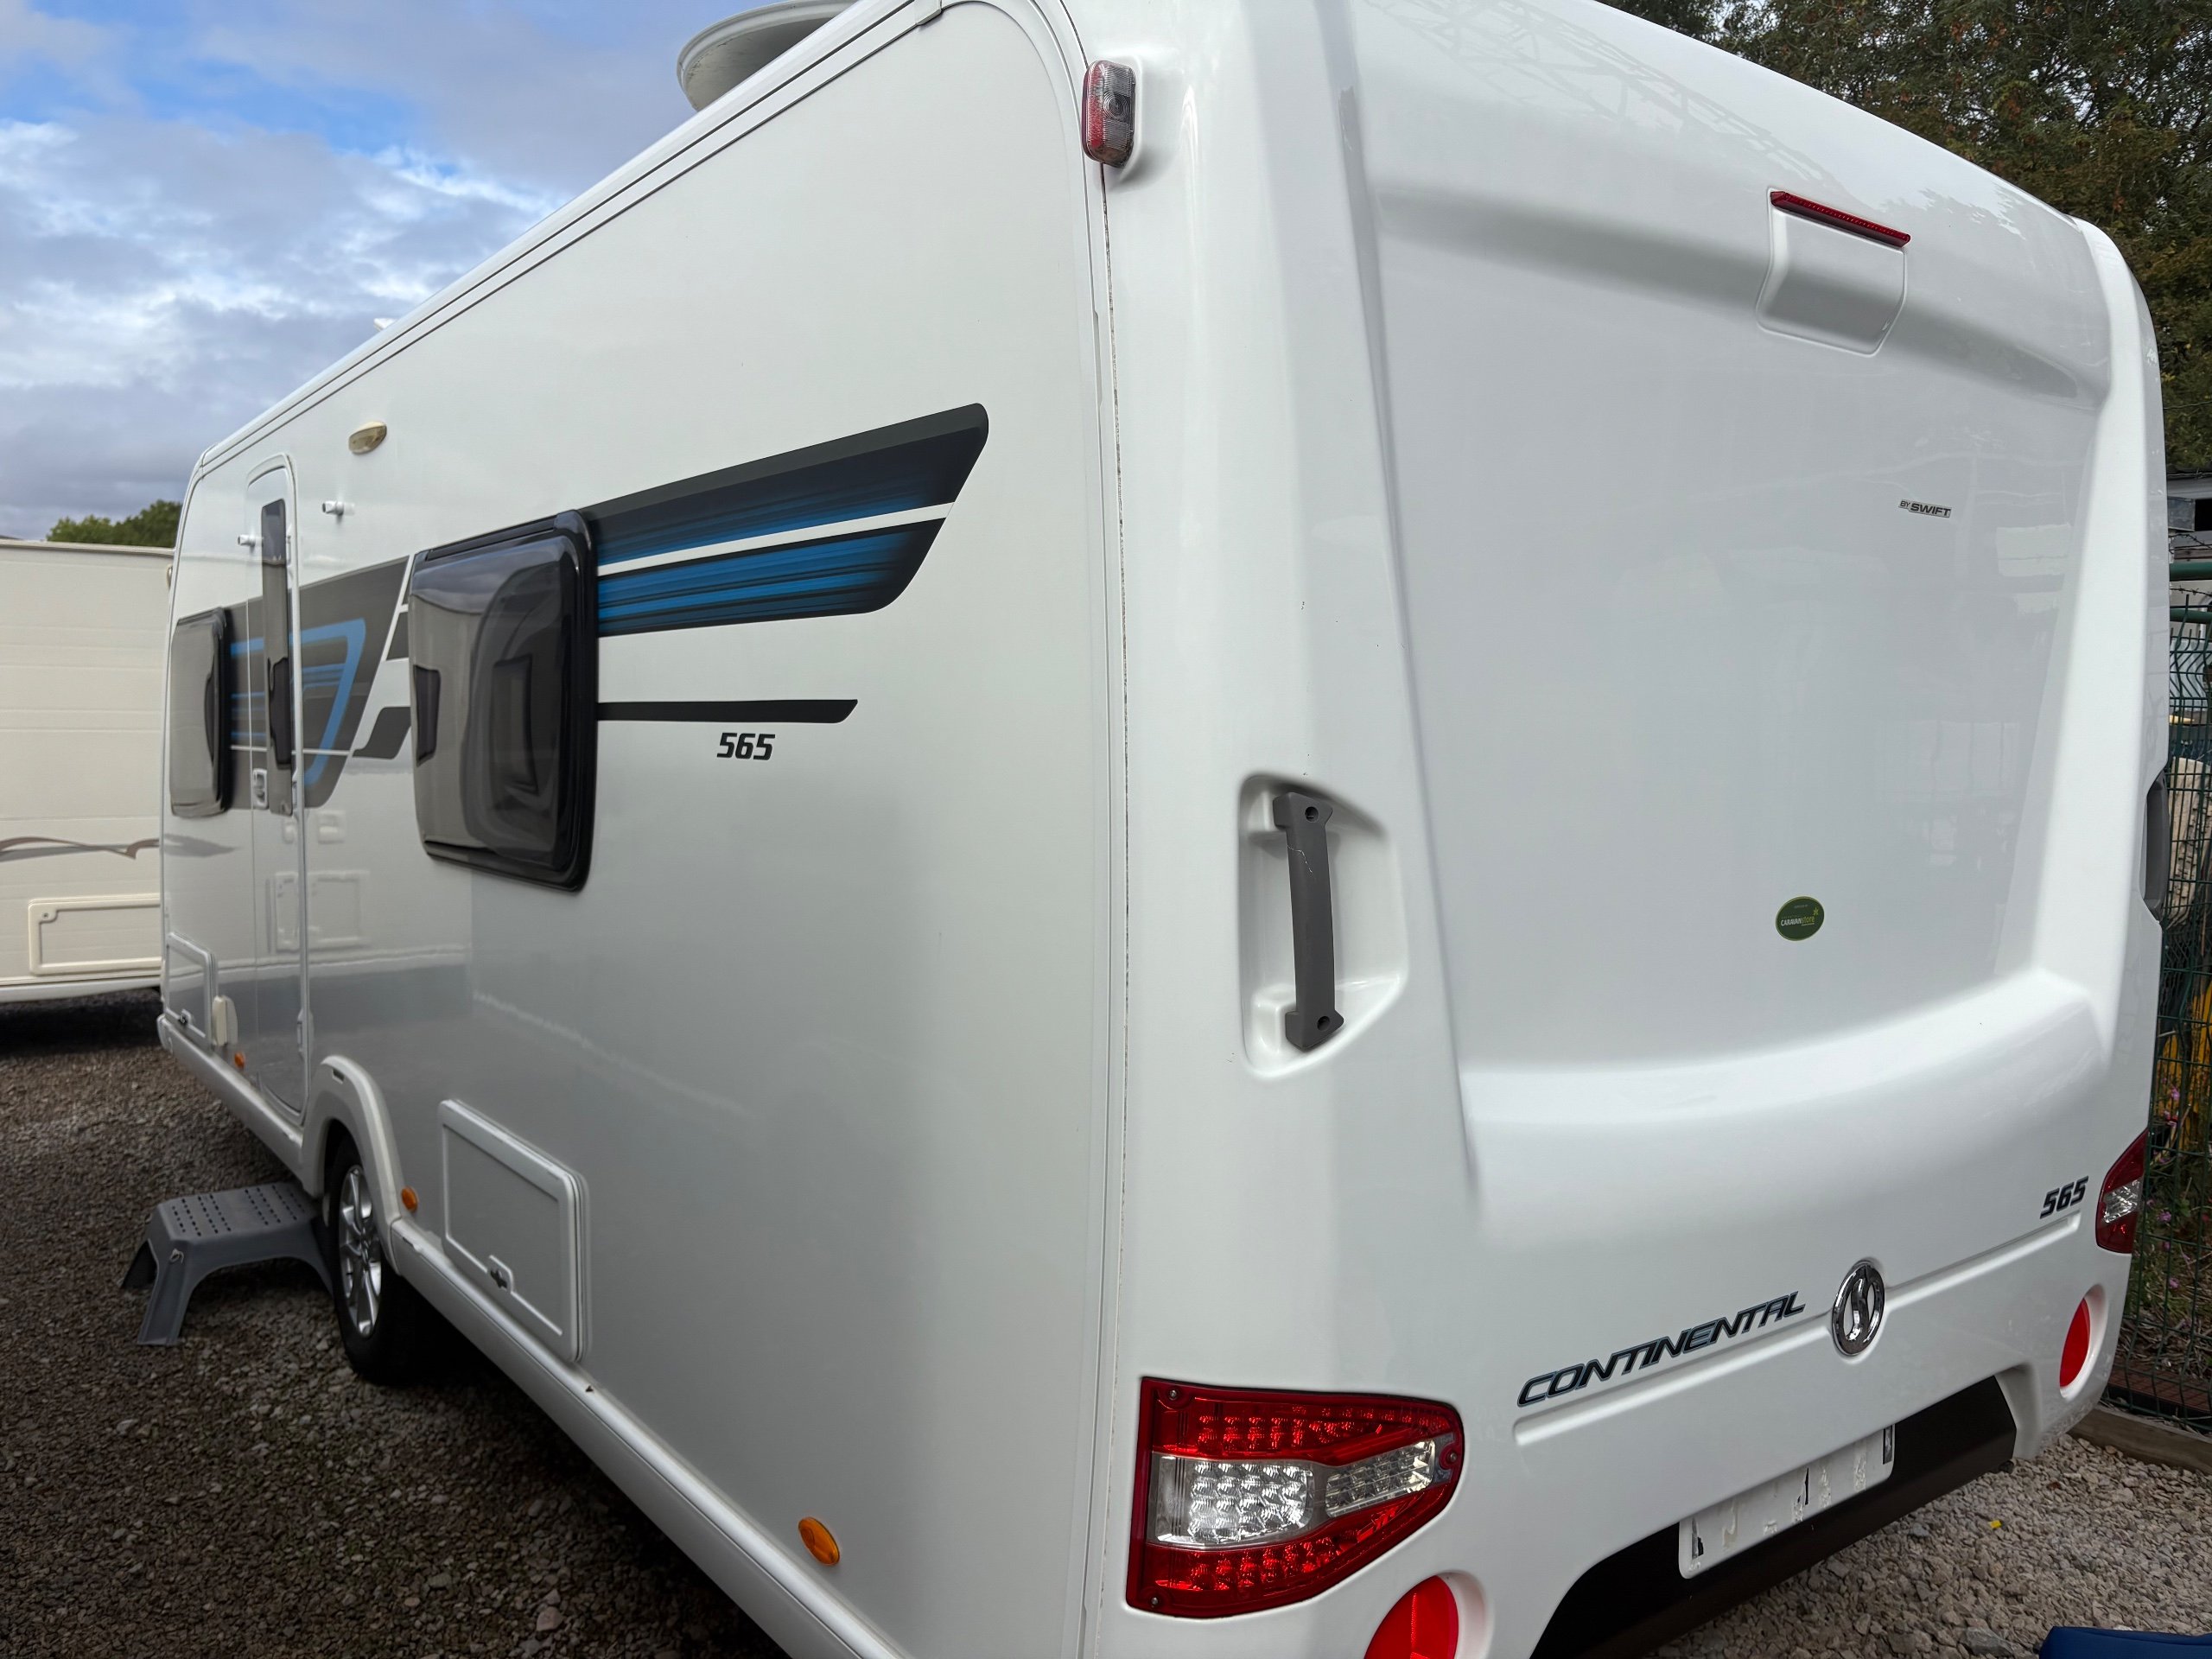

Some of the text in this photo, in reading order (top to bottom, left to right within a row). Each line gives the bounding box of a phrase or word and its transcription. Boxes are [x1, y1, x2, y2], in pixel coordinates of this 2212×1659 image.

[1910, 503, 1952, 517] SWIFT
[716, 732, 776, 760] 565
[2039, 1175, 2089, 1219] 565
[1517, 1291, 1806, 1407] CONTINENTAL
